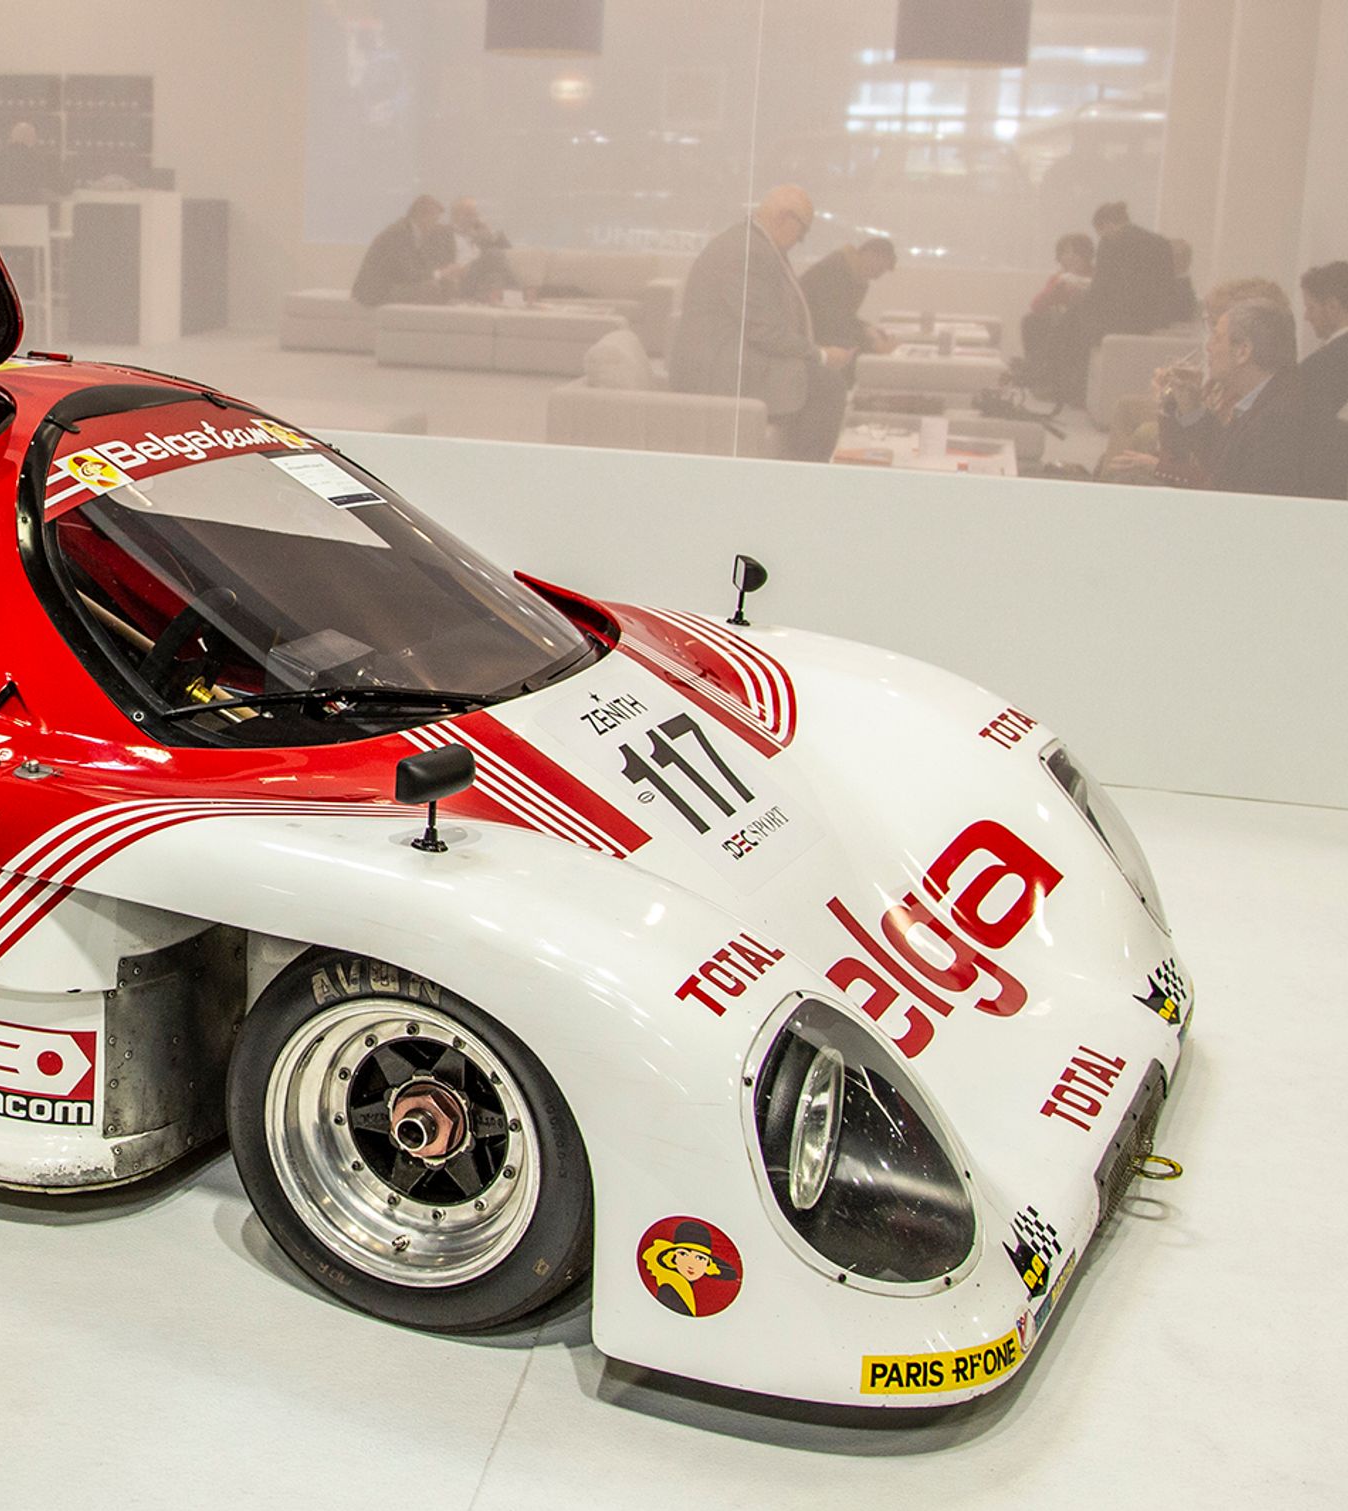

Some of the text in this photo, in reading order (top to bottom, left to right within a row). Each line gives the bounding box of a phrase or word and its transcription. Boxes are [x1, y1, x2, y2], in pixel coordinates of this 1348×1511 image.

[580, 694, 649, 736] ZENITH
[978, 707, 1039, 750] TOTA
[618, 712, 756, 835] 117
[746, 805, 790, 842] SPORT
[674, 932, 787, 1018] TOTAL
[1039, 1045, 1127, 1133] TOTAL
[870, 1360, 945, 1388] PARIS
